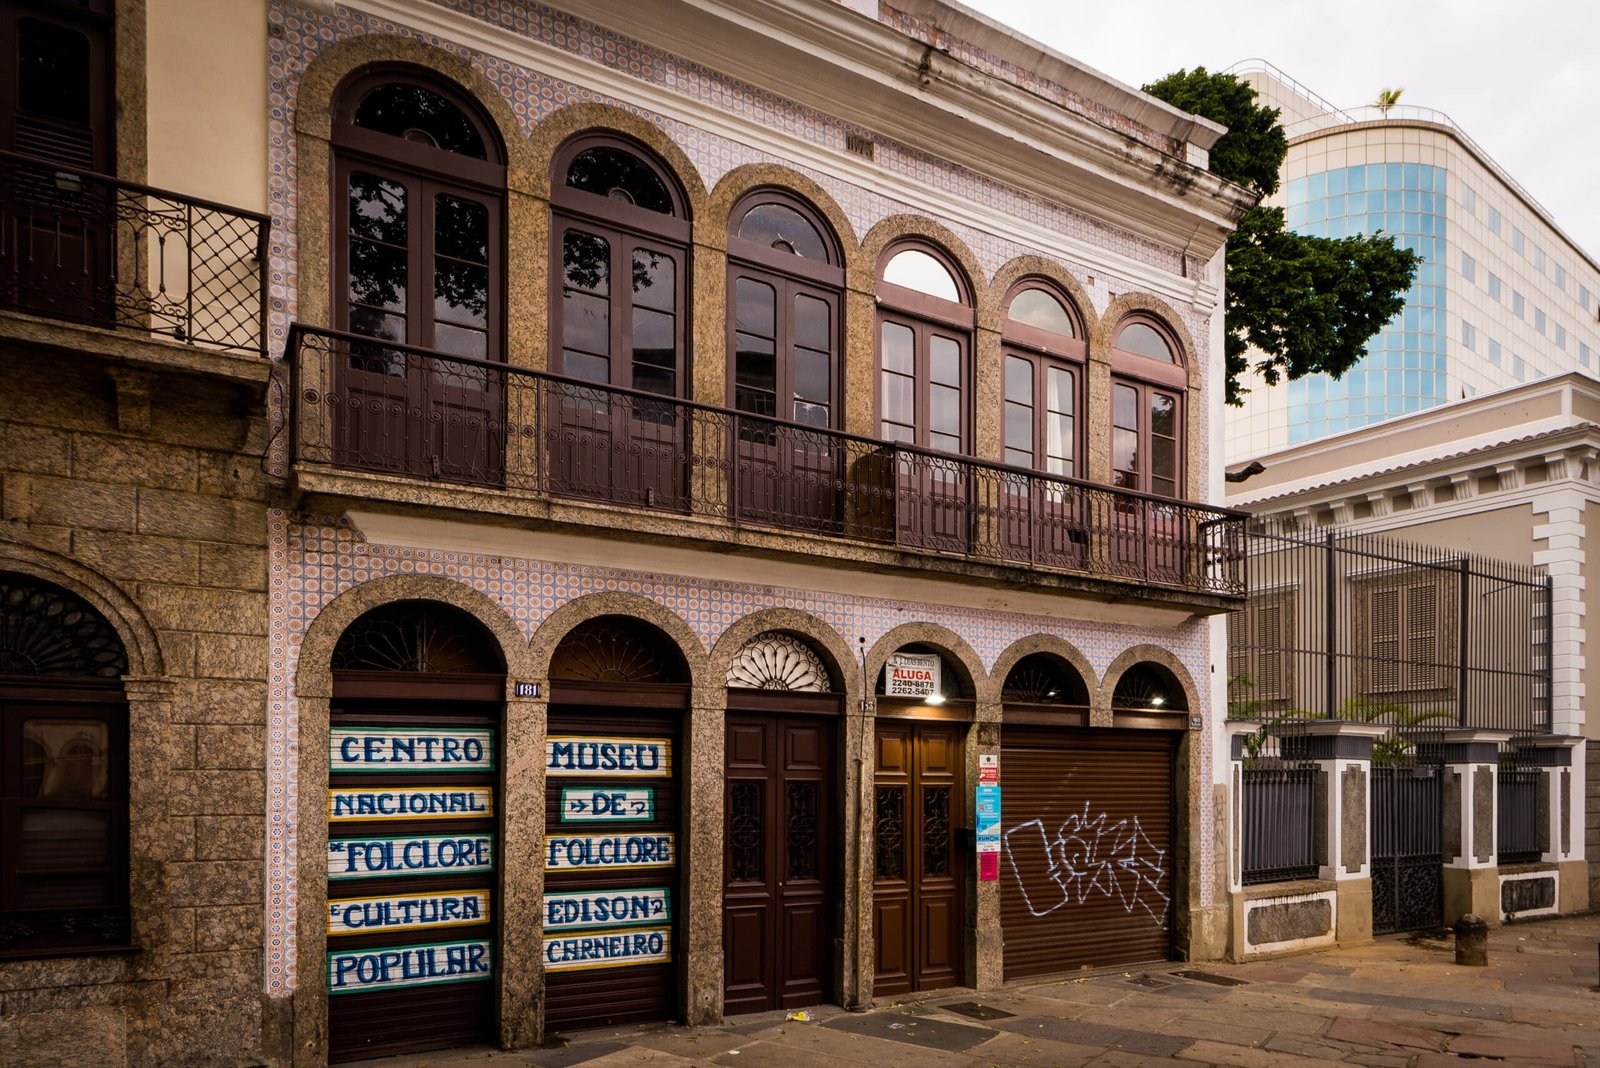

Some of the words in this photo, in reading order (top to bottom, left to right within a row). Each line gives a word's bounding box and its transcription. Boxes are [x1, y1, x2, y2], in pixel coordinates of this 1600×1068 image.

[892, 669, 932, 680] ALUGA
[892, 679, 934, 688] 2240-8878
[520, 684, 537, 695] 181
[892, 687, 934, 695] 2262-5407
[341, 736, 483, 763] CENTRO
[548, 742, 660, 770] MUSEU
[333, 792, 486, 816] NACIONAL
[591, 792, 626, 816] DE
[329, 841, 345, 853] DE
[345, 838, 490, 872] FOLCLORE
[547, 836, 671, 866] FOLCLORE
[330, 904, 341, 917] E
[342, 896, 481, 928] CULTURA
[548, 894, 650, 925] EDISON
[546, 931, 664, 963] CARNEIRO
[333, 942, 488, 987] POPULAR
